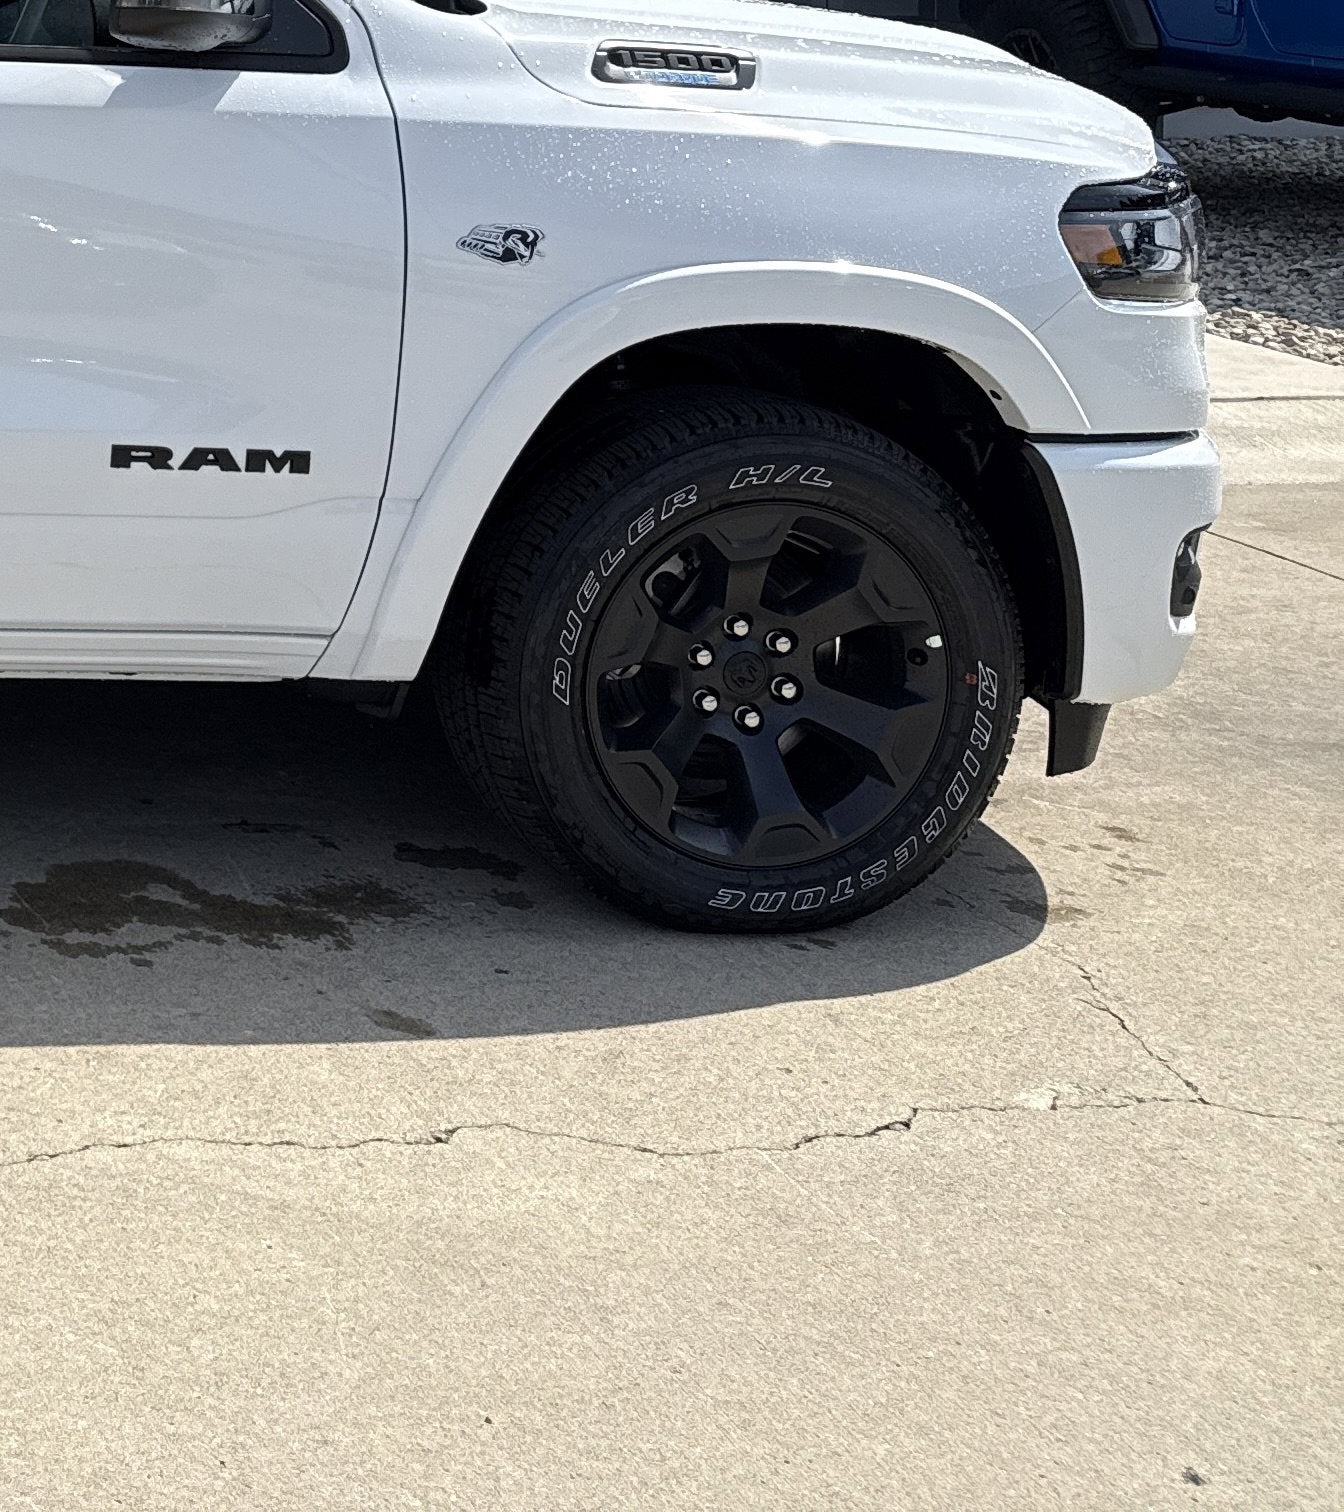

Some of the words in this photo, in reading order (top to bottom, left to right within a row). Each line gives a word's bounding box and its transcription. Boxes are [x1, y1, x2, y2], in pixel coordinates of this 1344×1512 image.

[615, 50, 732, 71] 1500
[110, 444, 311, 474] RAM
[552, 484, 698, 705] DUELER
[729, 464, 833, 489] H/L
[708, 660, 999, 913] BRIDGESTONE
